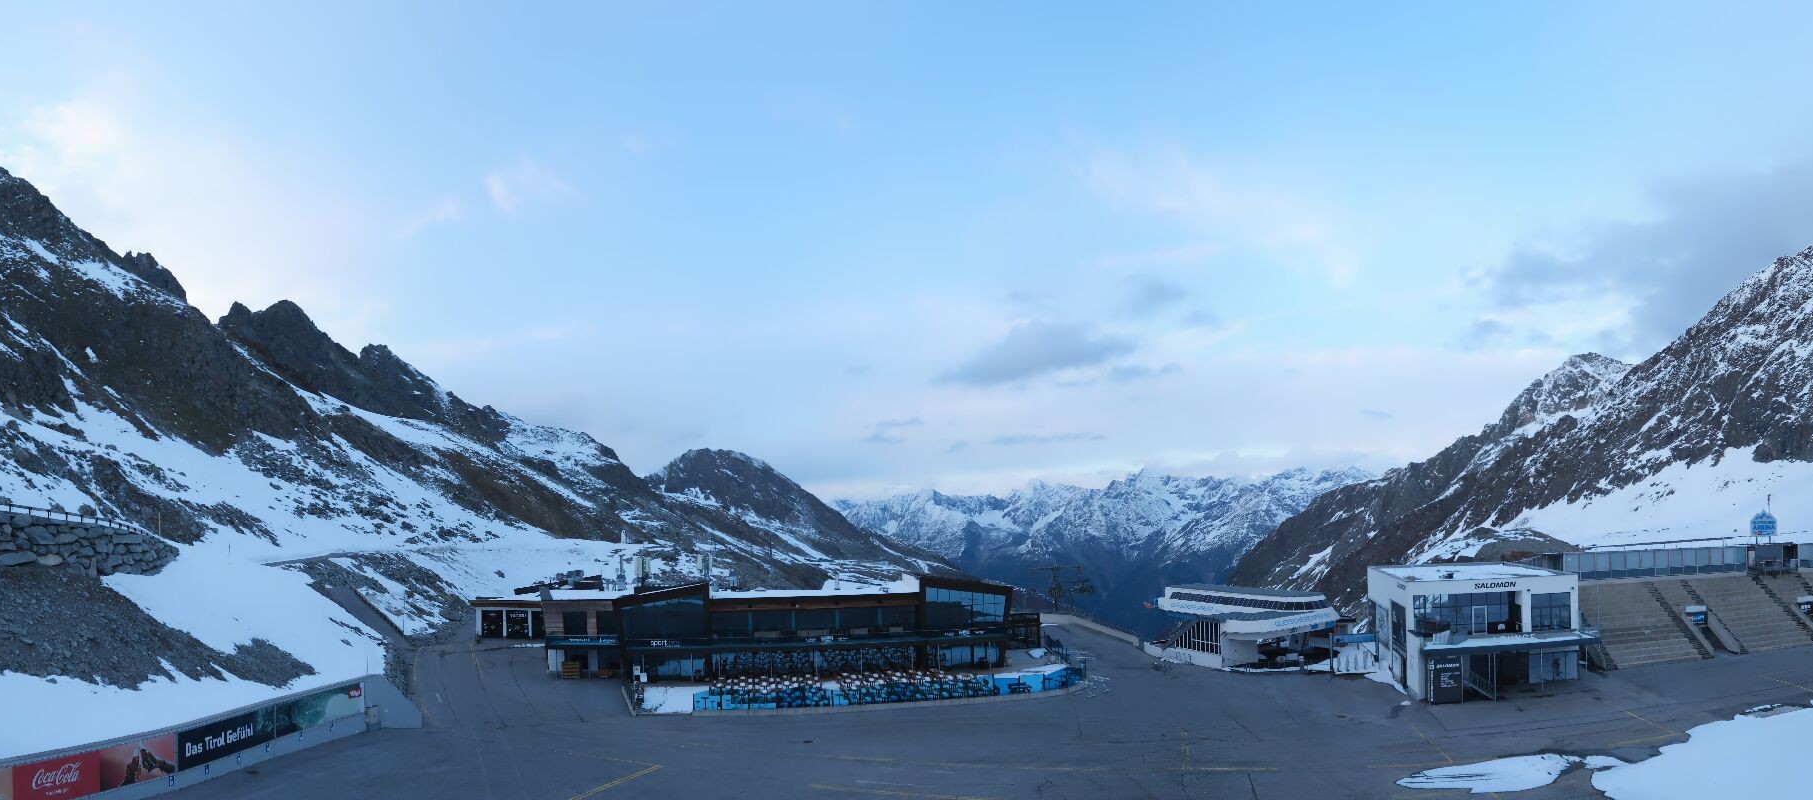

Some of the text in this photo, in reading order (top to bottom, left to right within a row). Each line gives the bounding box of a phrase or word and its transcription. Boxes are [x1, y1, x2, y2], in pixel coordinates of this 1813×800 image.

[1474, 581, 1516, 589] SALOMON
[185, 723, 254, 758] Das Tirol Gefühl
